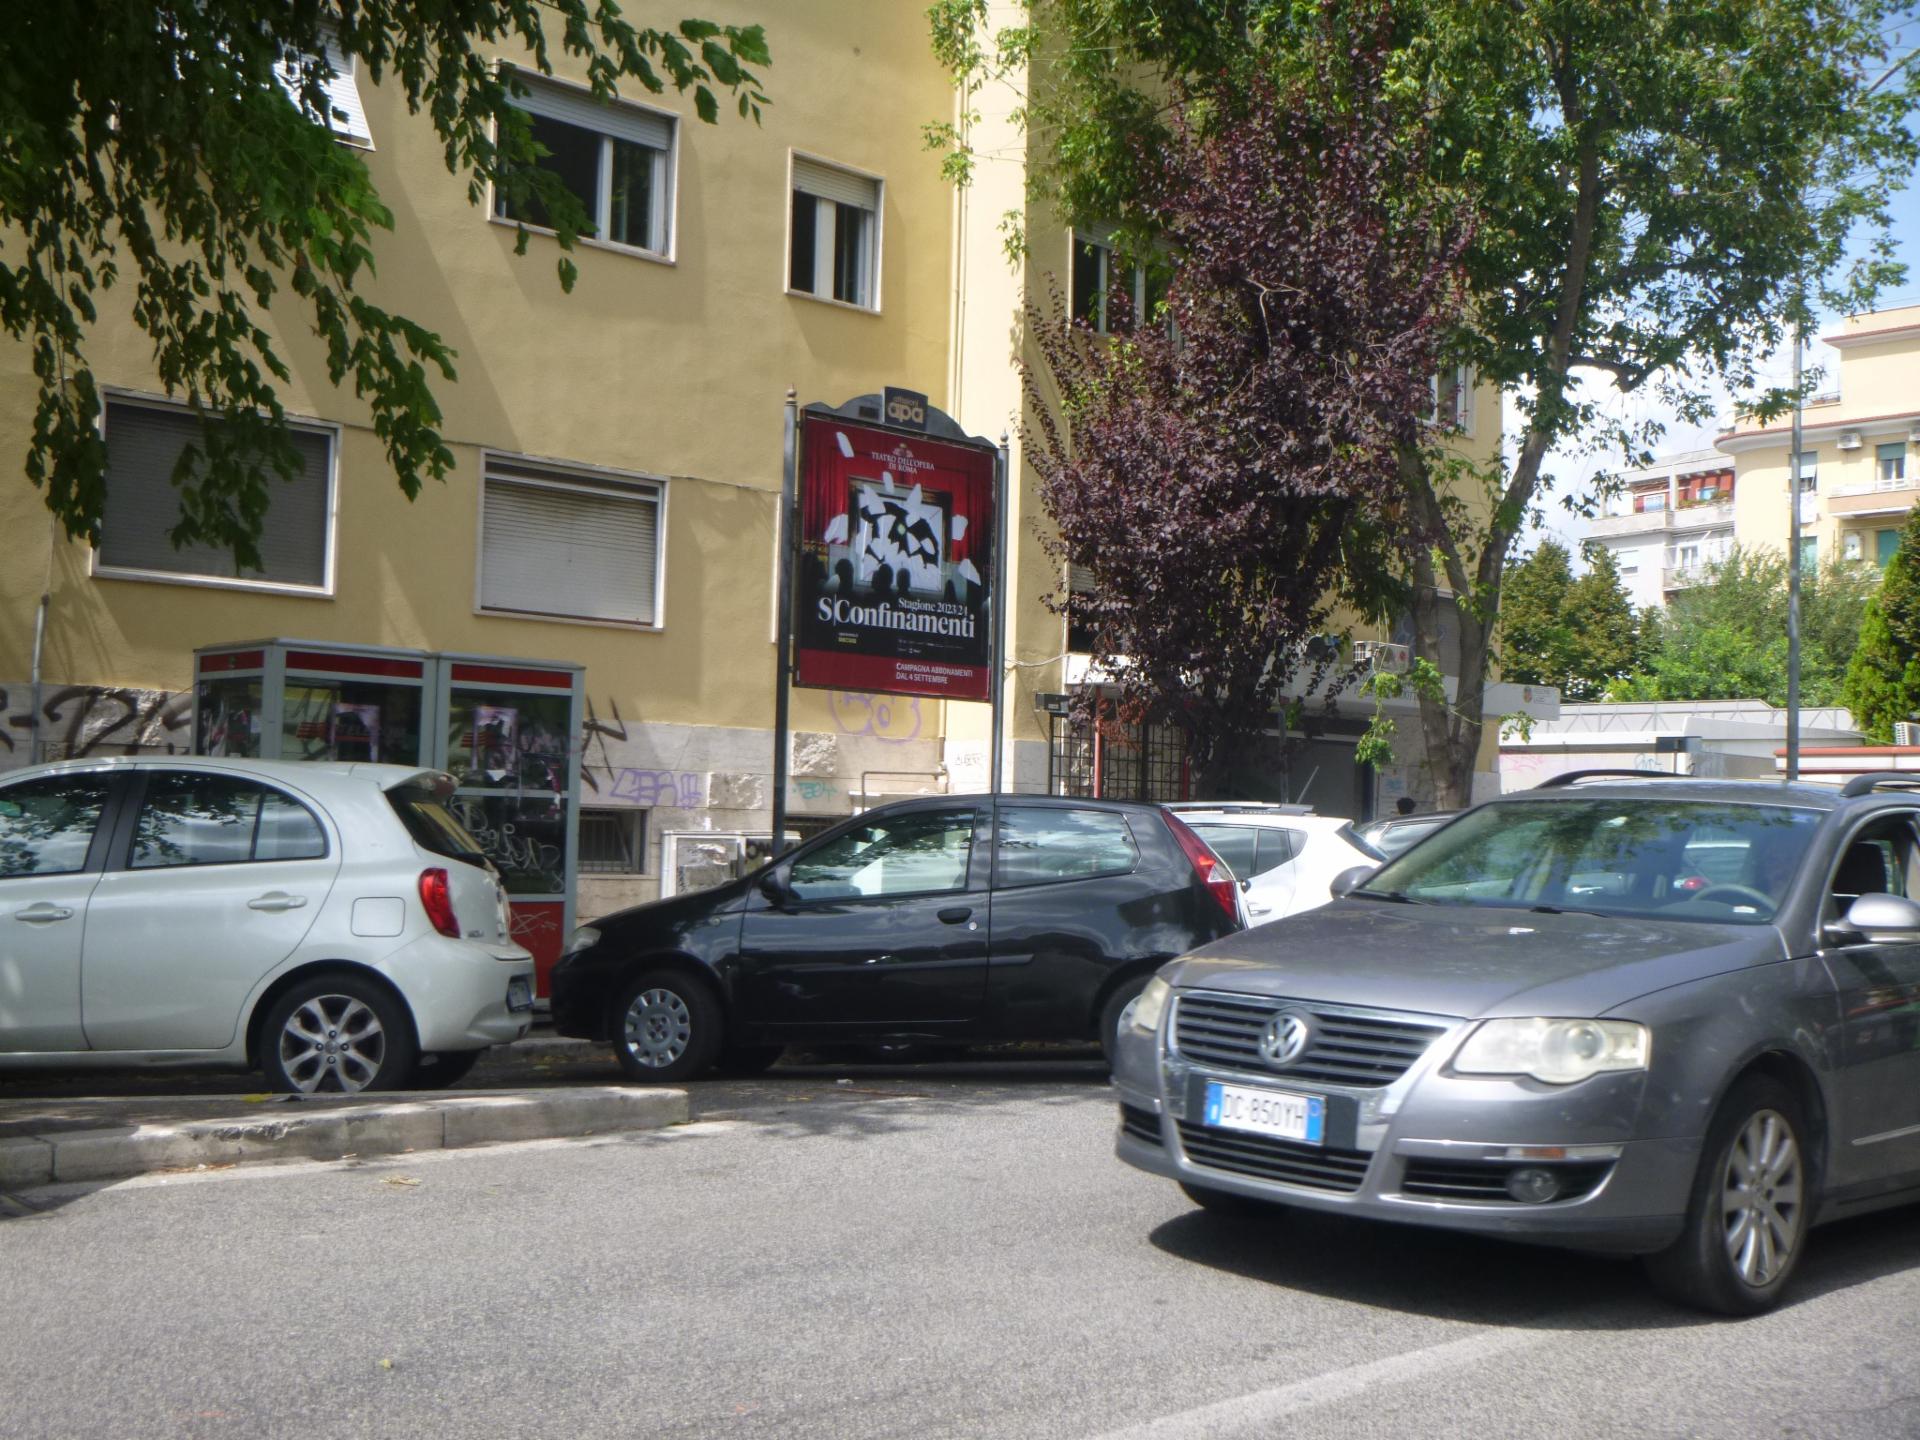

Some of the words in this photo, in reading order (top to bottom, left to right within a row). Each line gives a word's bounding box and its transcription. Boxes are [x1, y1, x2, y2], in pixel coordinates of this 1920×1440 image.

[888, 402, 924, 423] apa
[872, 451, 897, 463] TEATRO
[888, 462, 897, 470] DI
[898, 464, 918, 475] ROMA
[898, 597, 935, 612] Stagione
[896, 662, 930, 673] CAMPAGNA
[931, 666, 974, 677] ABBONAMENTI
[896, 671, 909, 681] DAL
[914, 674, 948, 684] SETTEMBRE
